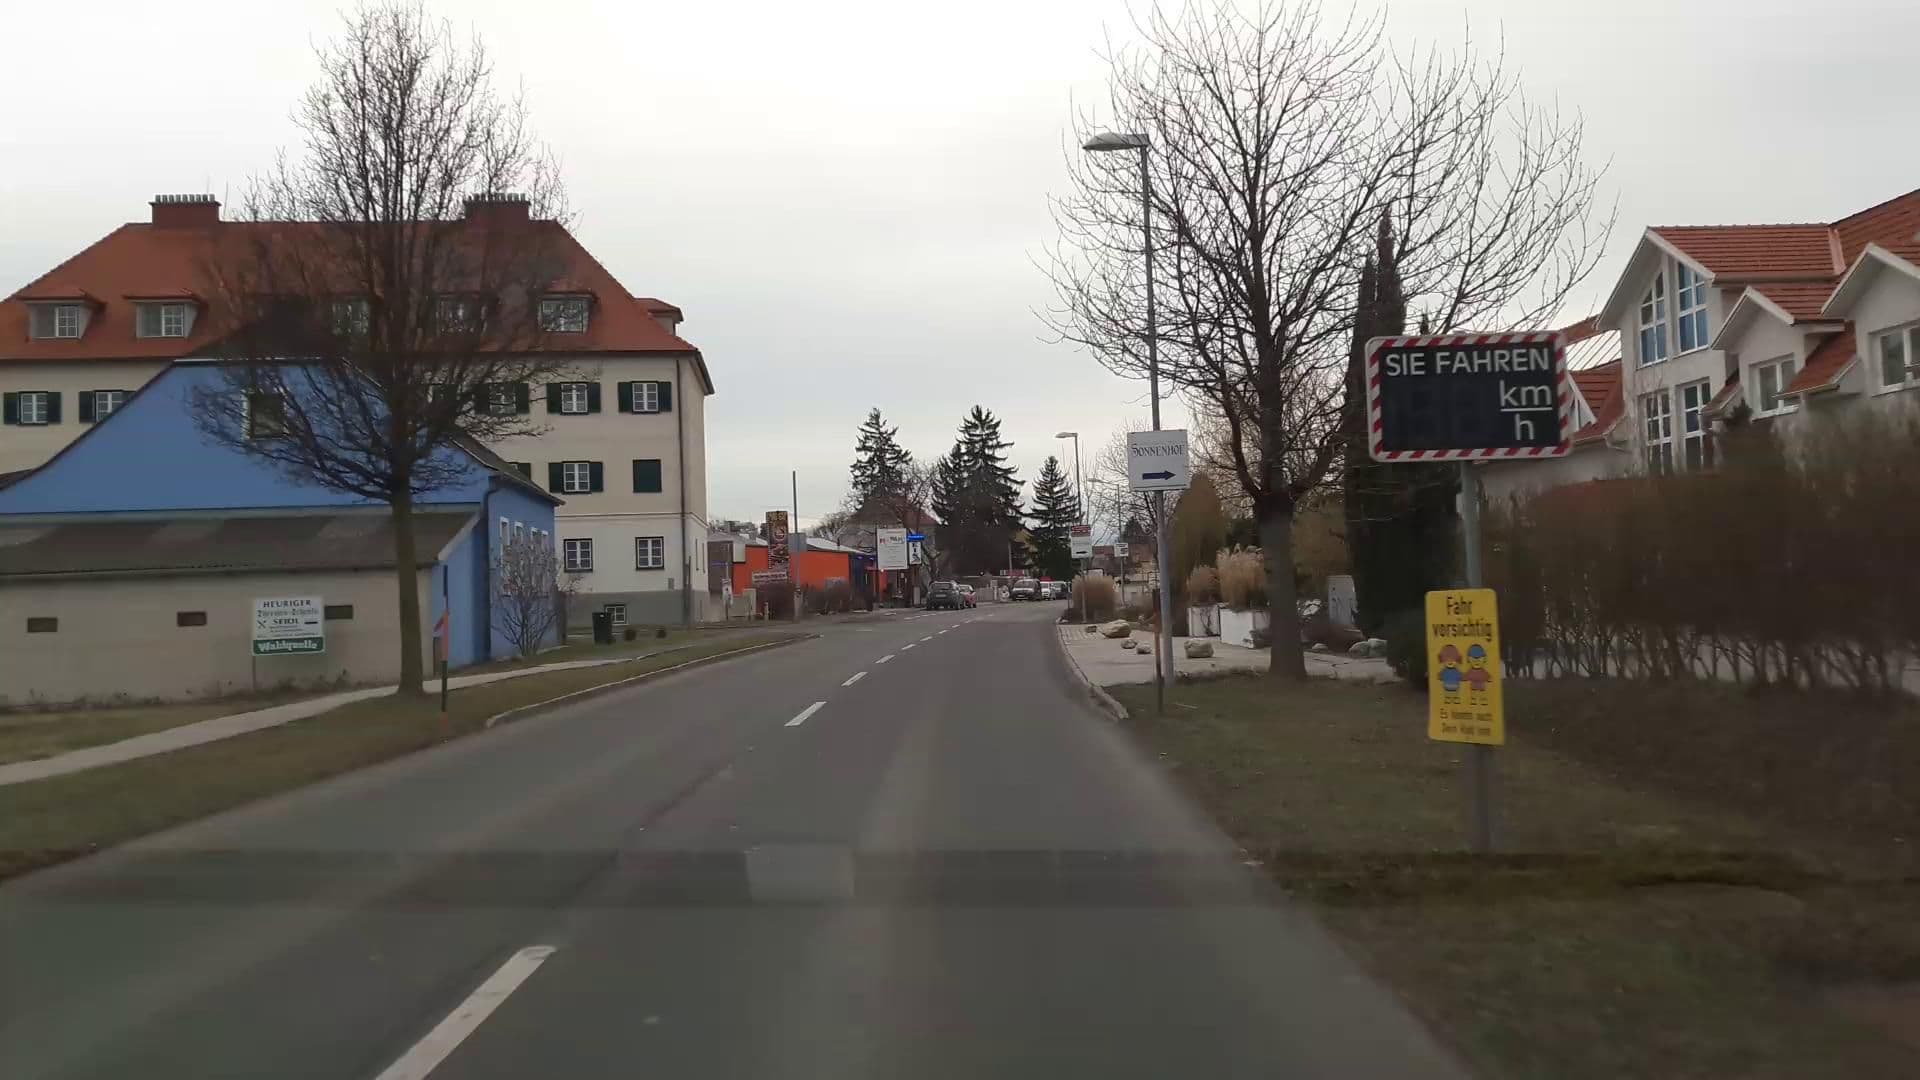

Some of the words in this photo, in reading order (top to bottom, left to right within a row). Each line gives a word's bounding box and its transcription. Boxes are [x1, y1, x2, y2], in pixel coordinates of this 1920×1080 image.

[1385, 352, 1425, 377] SIE
[1435, 347, 1549, 374] FAHREN
[1499, 379, 1552, 407] km
[1514, 413, 1535, 441] h
[1131, 443, 1185, 457] SONNENHOF
[263, 599, 311, 609] HEURIGER
[1445, 595, 1473, 616] Fahr
[1432, 617, 1493, 643] vorsichtig
